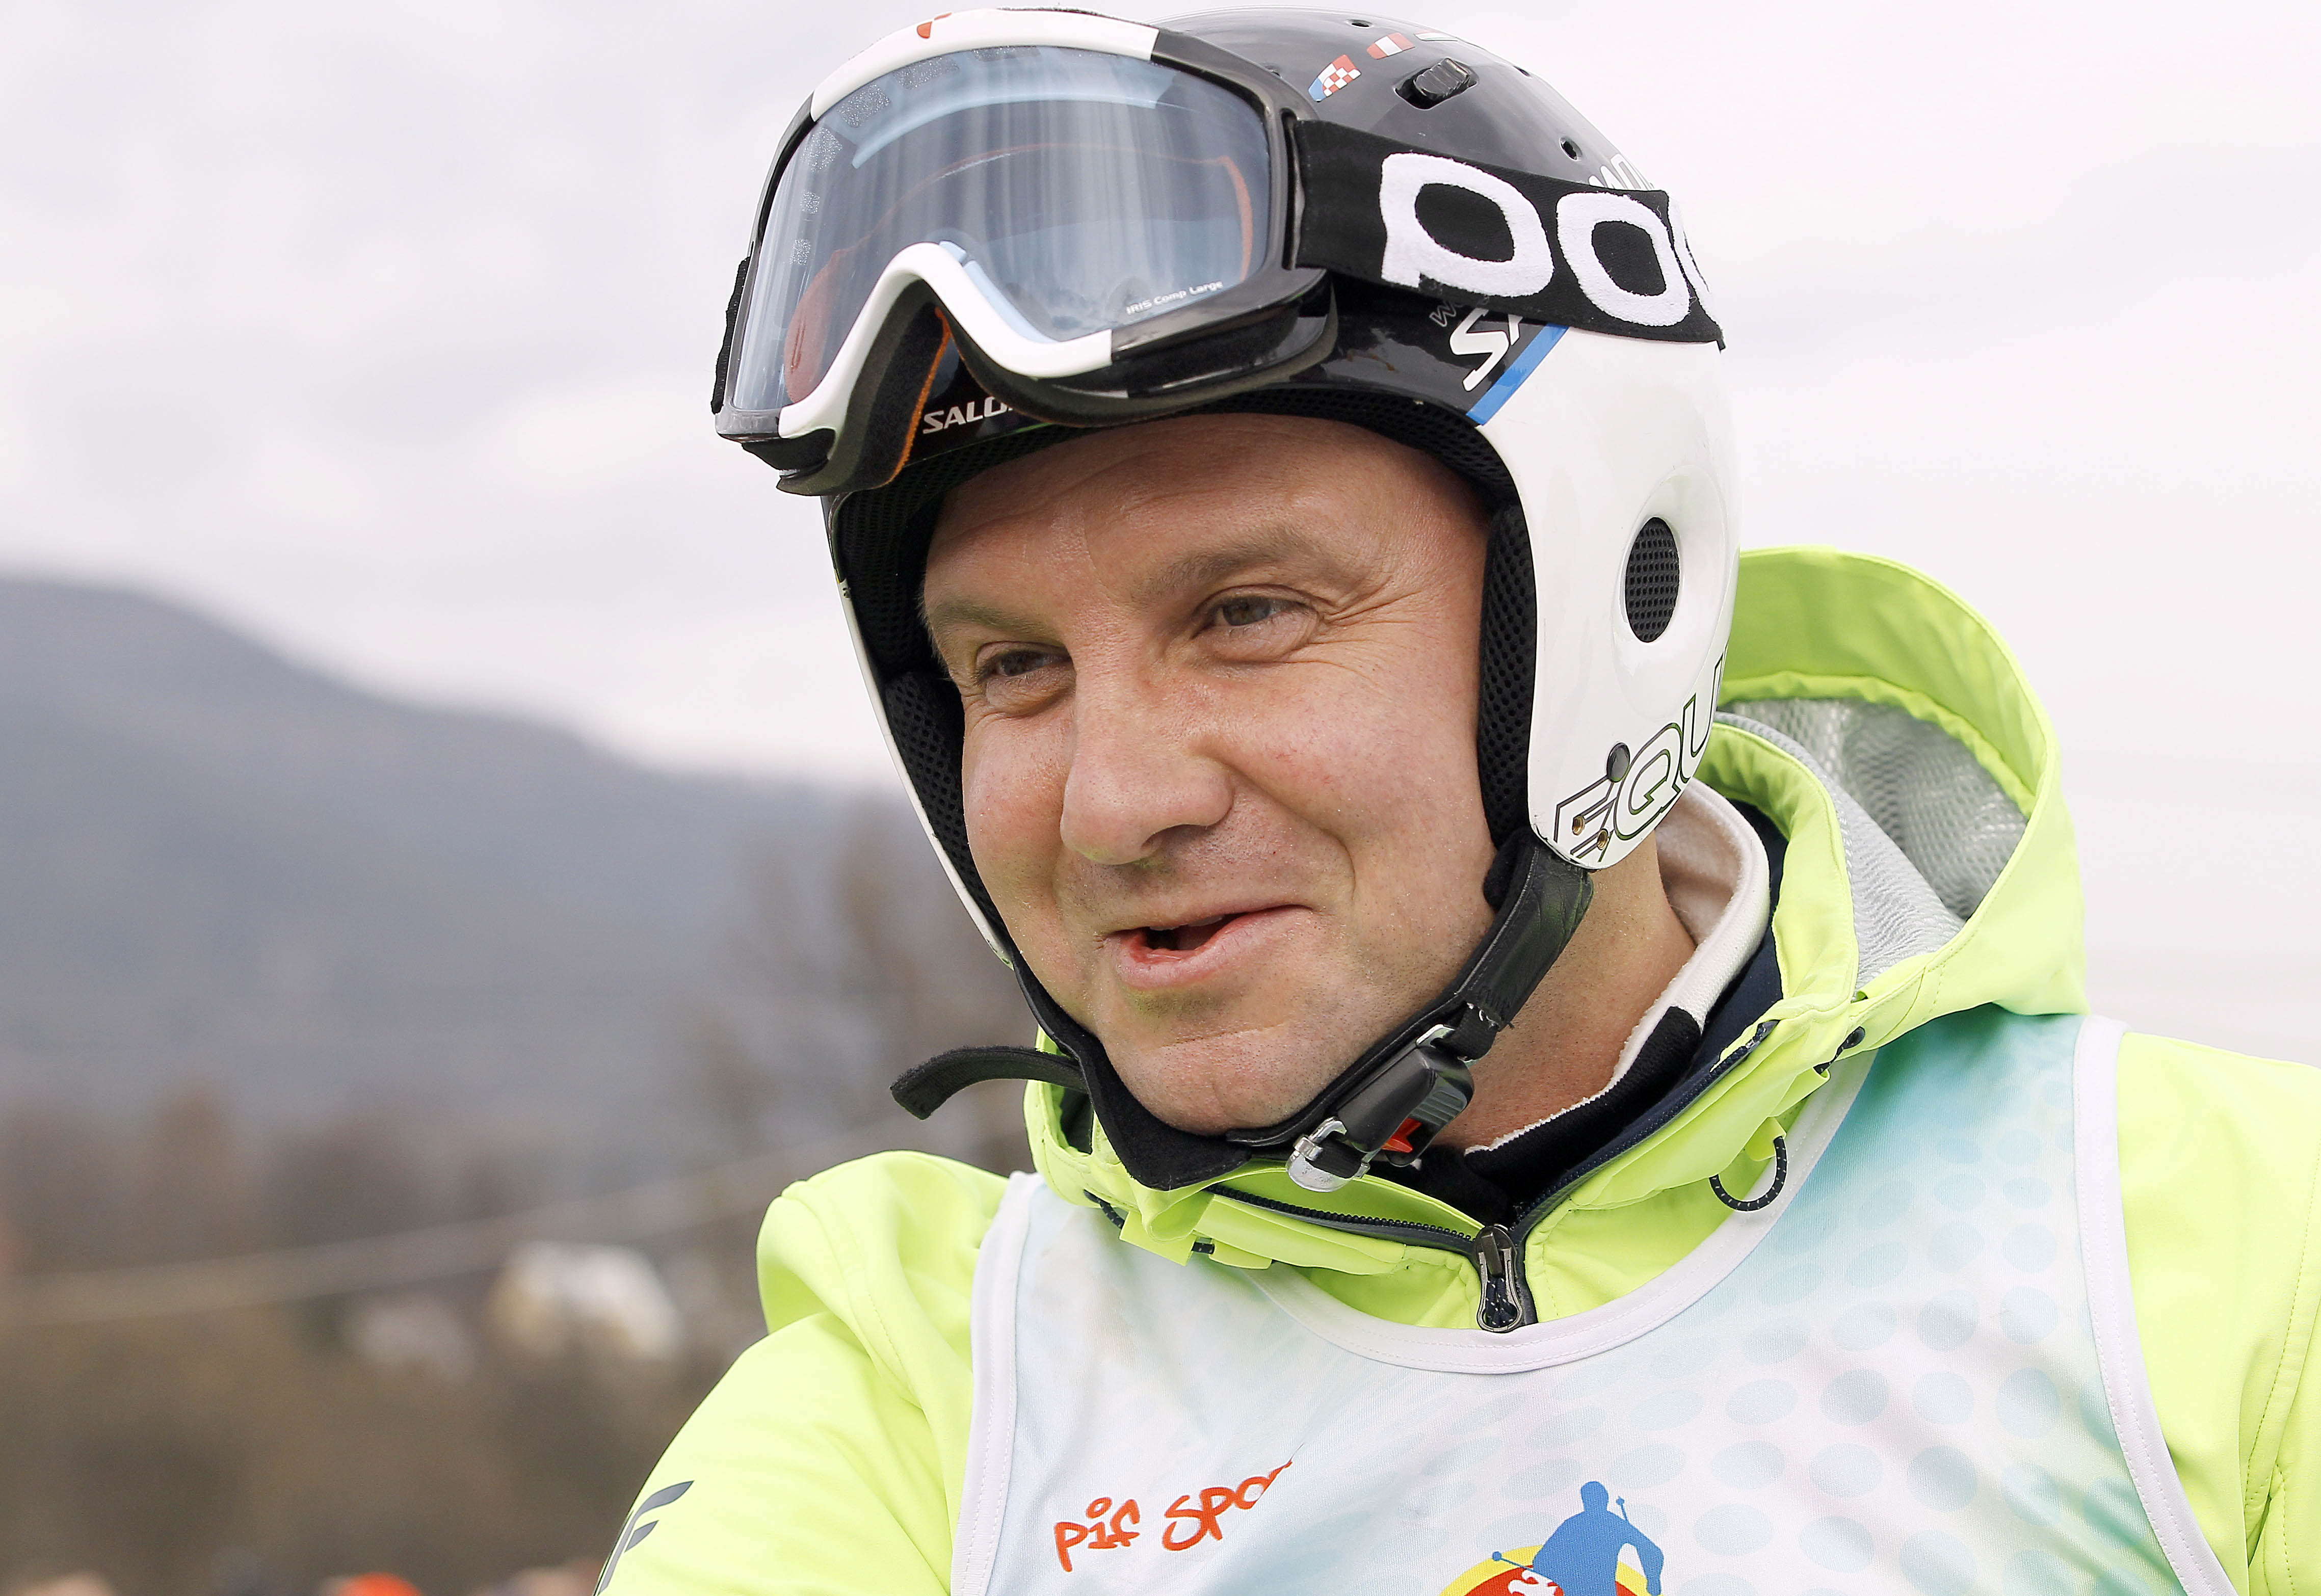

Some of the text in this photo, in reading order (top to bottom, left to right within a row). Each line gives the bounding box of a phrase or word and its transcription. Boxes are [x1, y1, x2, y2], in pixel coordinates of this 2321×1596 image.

[1126, 281, 1223, 315] IRIS Comp Large
[922, 395, 1013, 434] SALO
[1553, 644, 1728, 862] EQU
